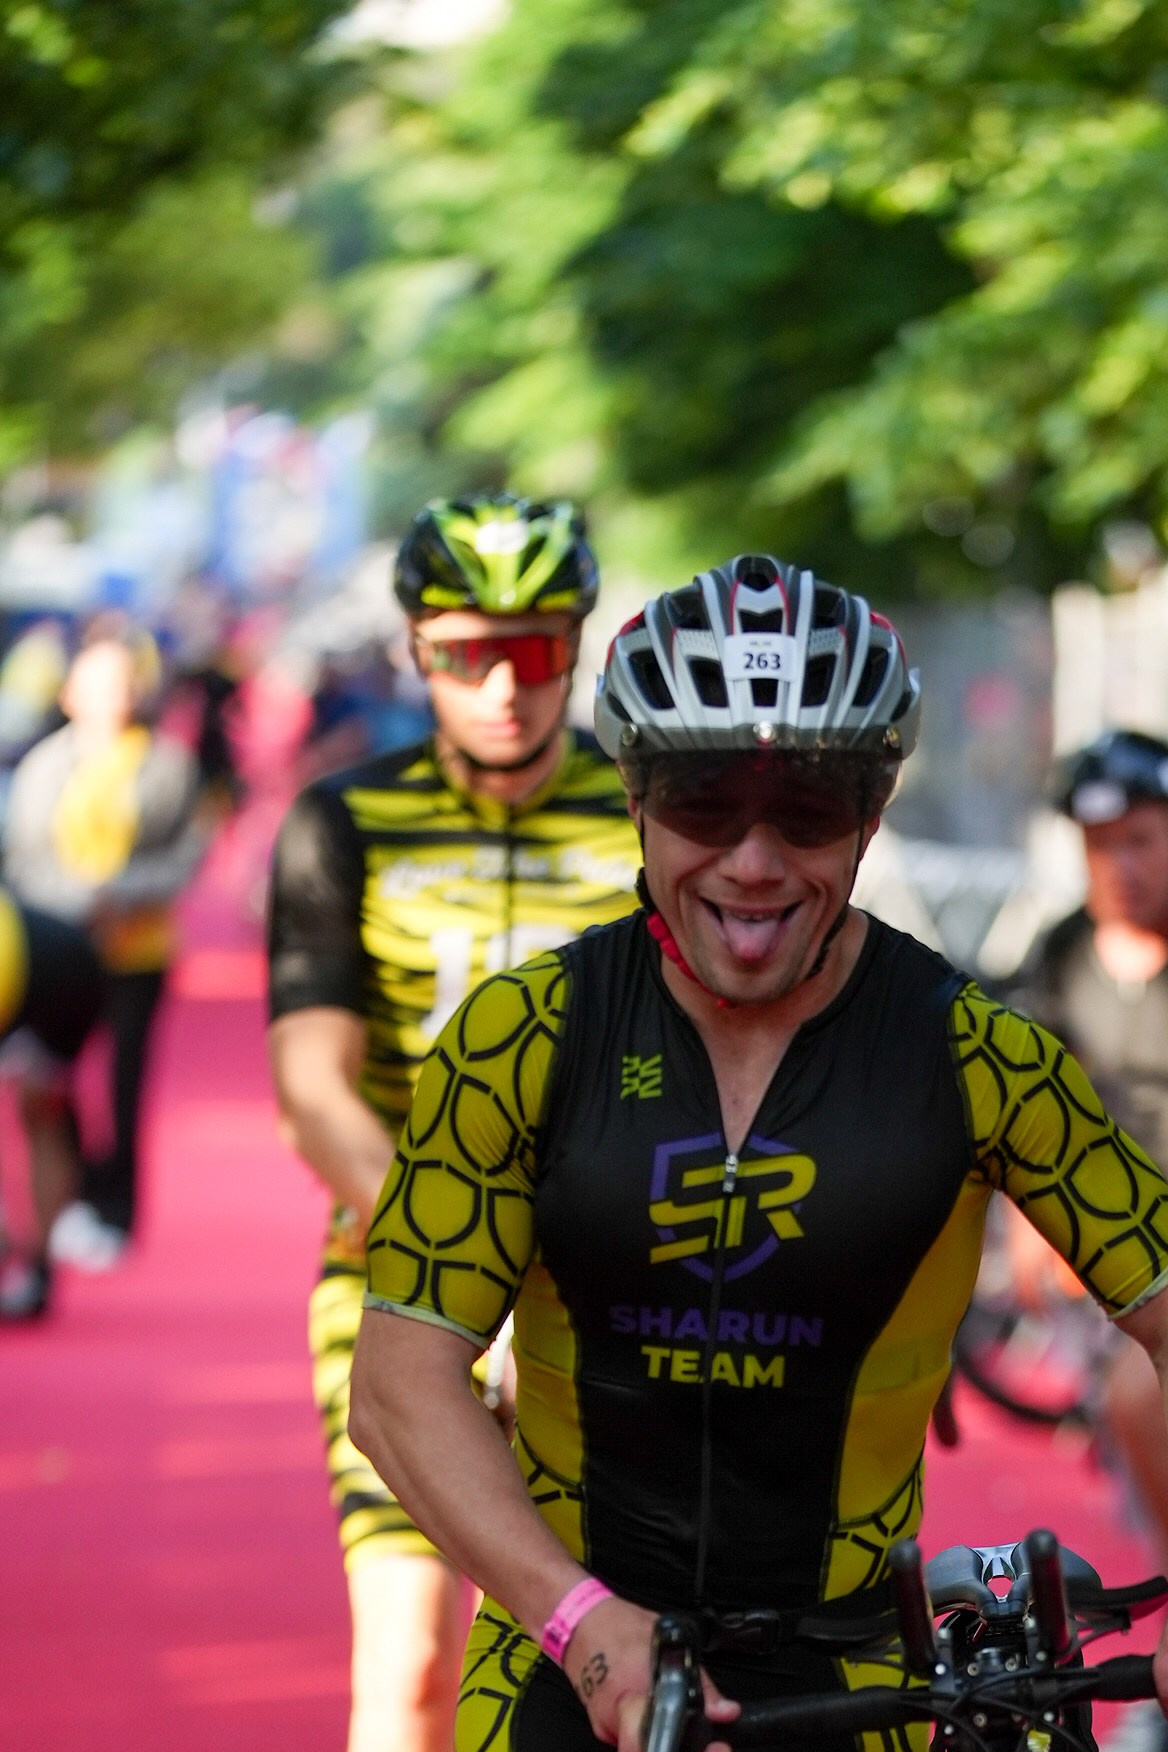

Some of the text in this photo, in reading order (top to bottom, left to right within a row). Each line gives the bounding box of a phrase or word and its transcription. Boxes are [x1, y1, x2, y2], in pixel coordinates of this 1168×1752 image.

[743, 651, 782, 670] 263
[609, 1305, 824, 1346] SHARUN
[640, 1345, 785, 1388] TEAM
